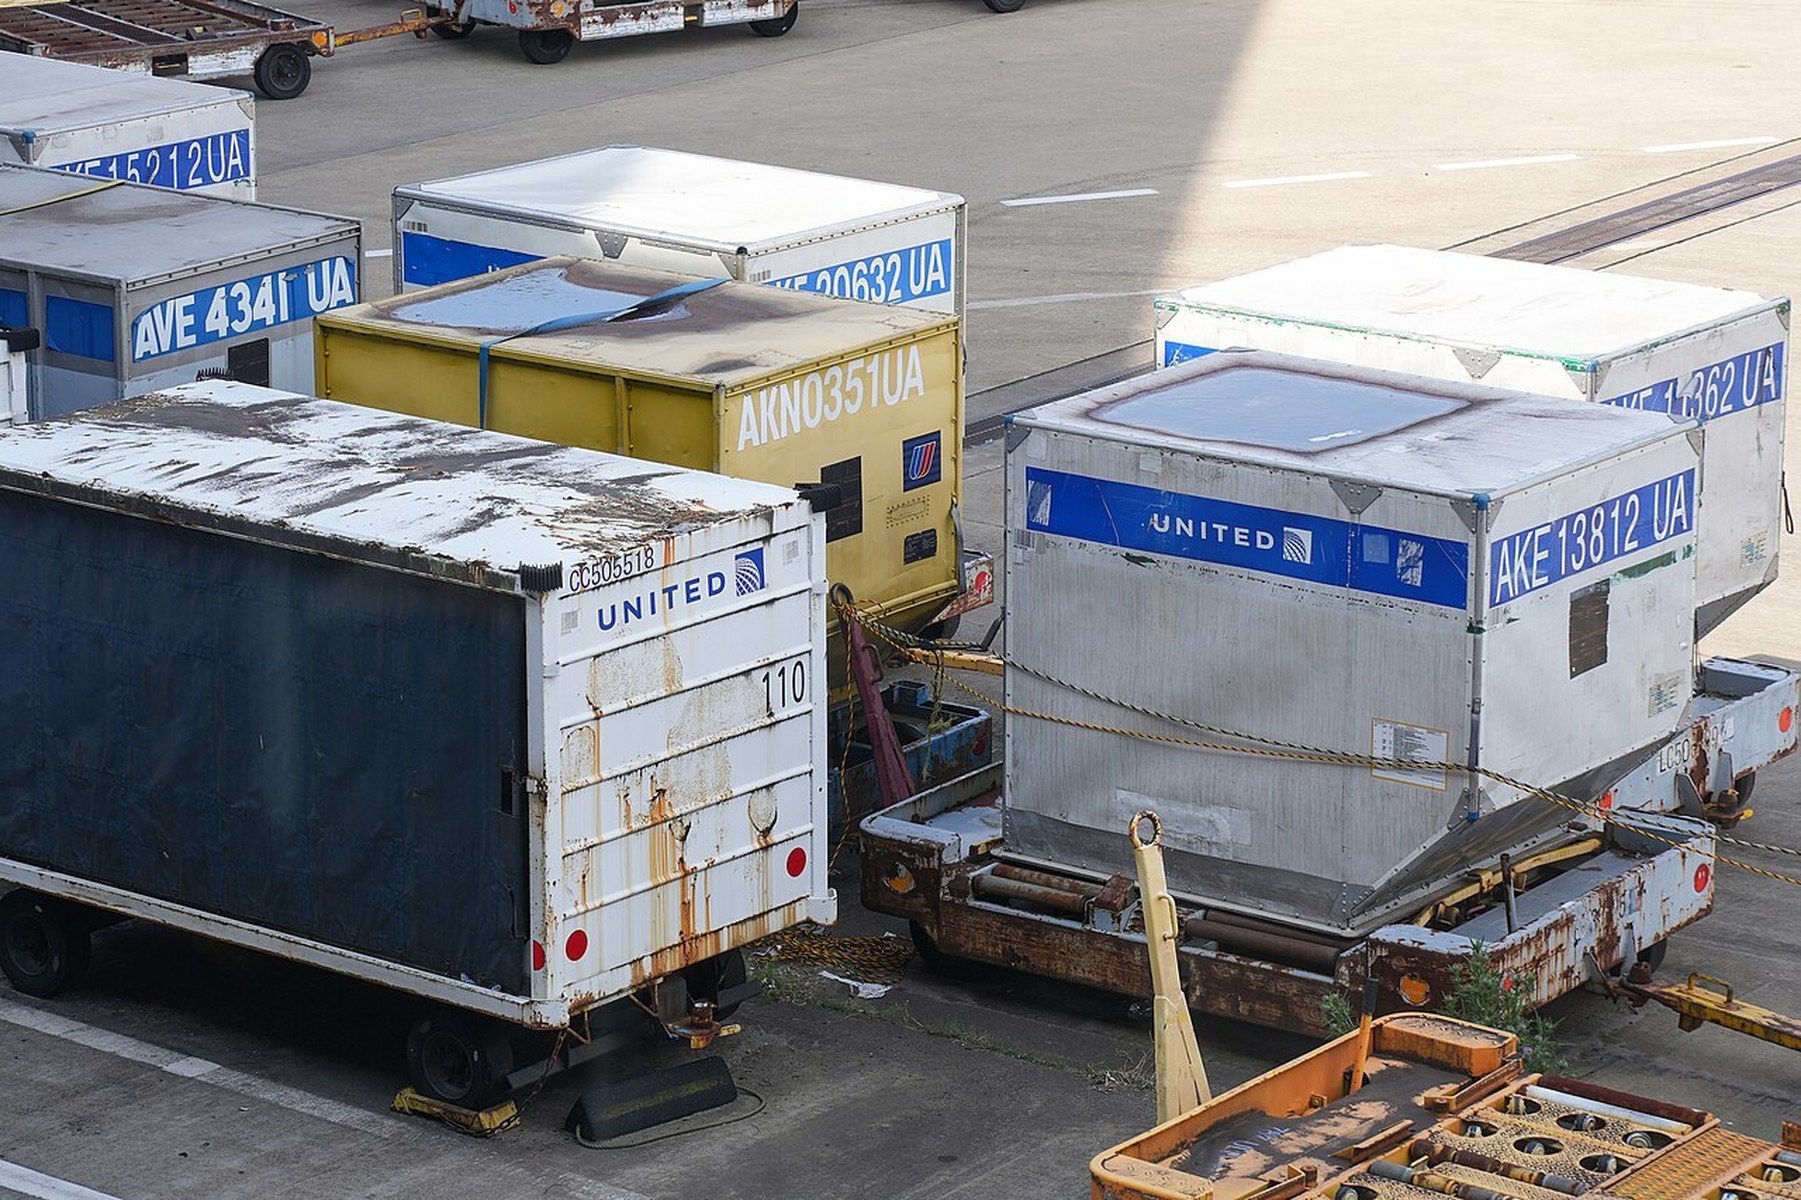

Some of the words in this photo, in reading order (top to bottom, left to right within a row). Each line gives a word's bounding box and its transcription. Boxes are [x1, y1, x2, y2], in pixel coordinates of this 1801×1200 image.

[909, 243, 947, 296] UA
[134, 294, 197, 360] AVE
[305, 256, 355, 313] UA
[1742, 346, 1778, 407] UA
[1152, 512, 1275, 551] UNITED
[1494, 523, 1553, 604] AKE
[1558, 493, 1641, 576] 13812
[1653, 474, 1689, 541] UA
[570, 546, 655, 593] CC505518
[597, 571, 727, 632] UNITED
[762, 660, 806, 718] 110
